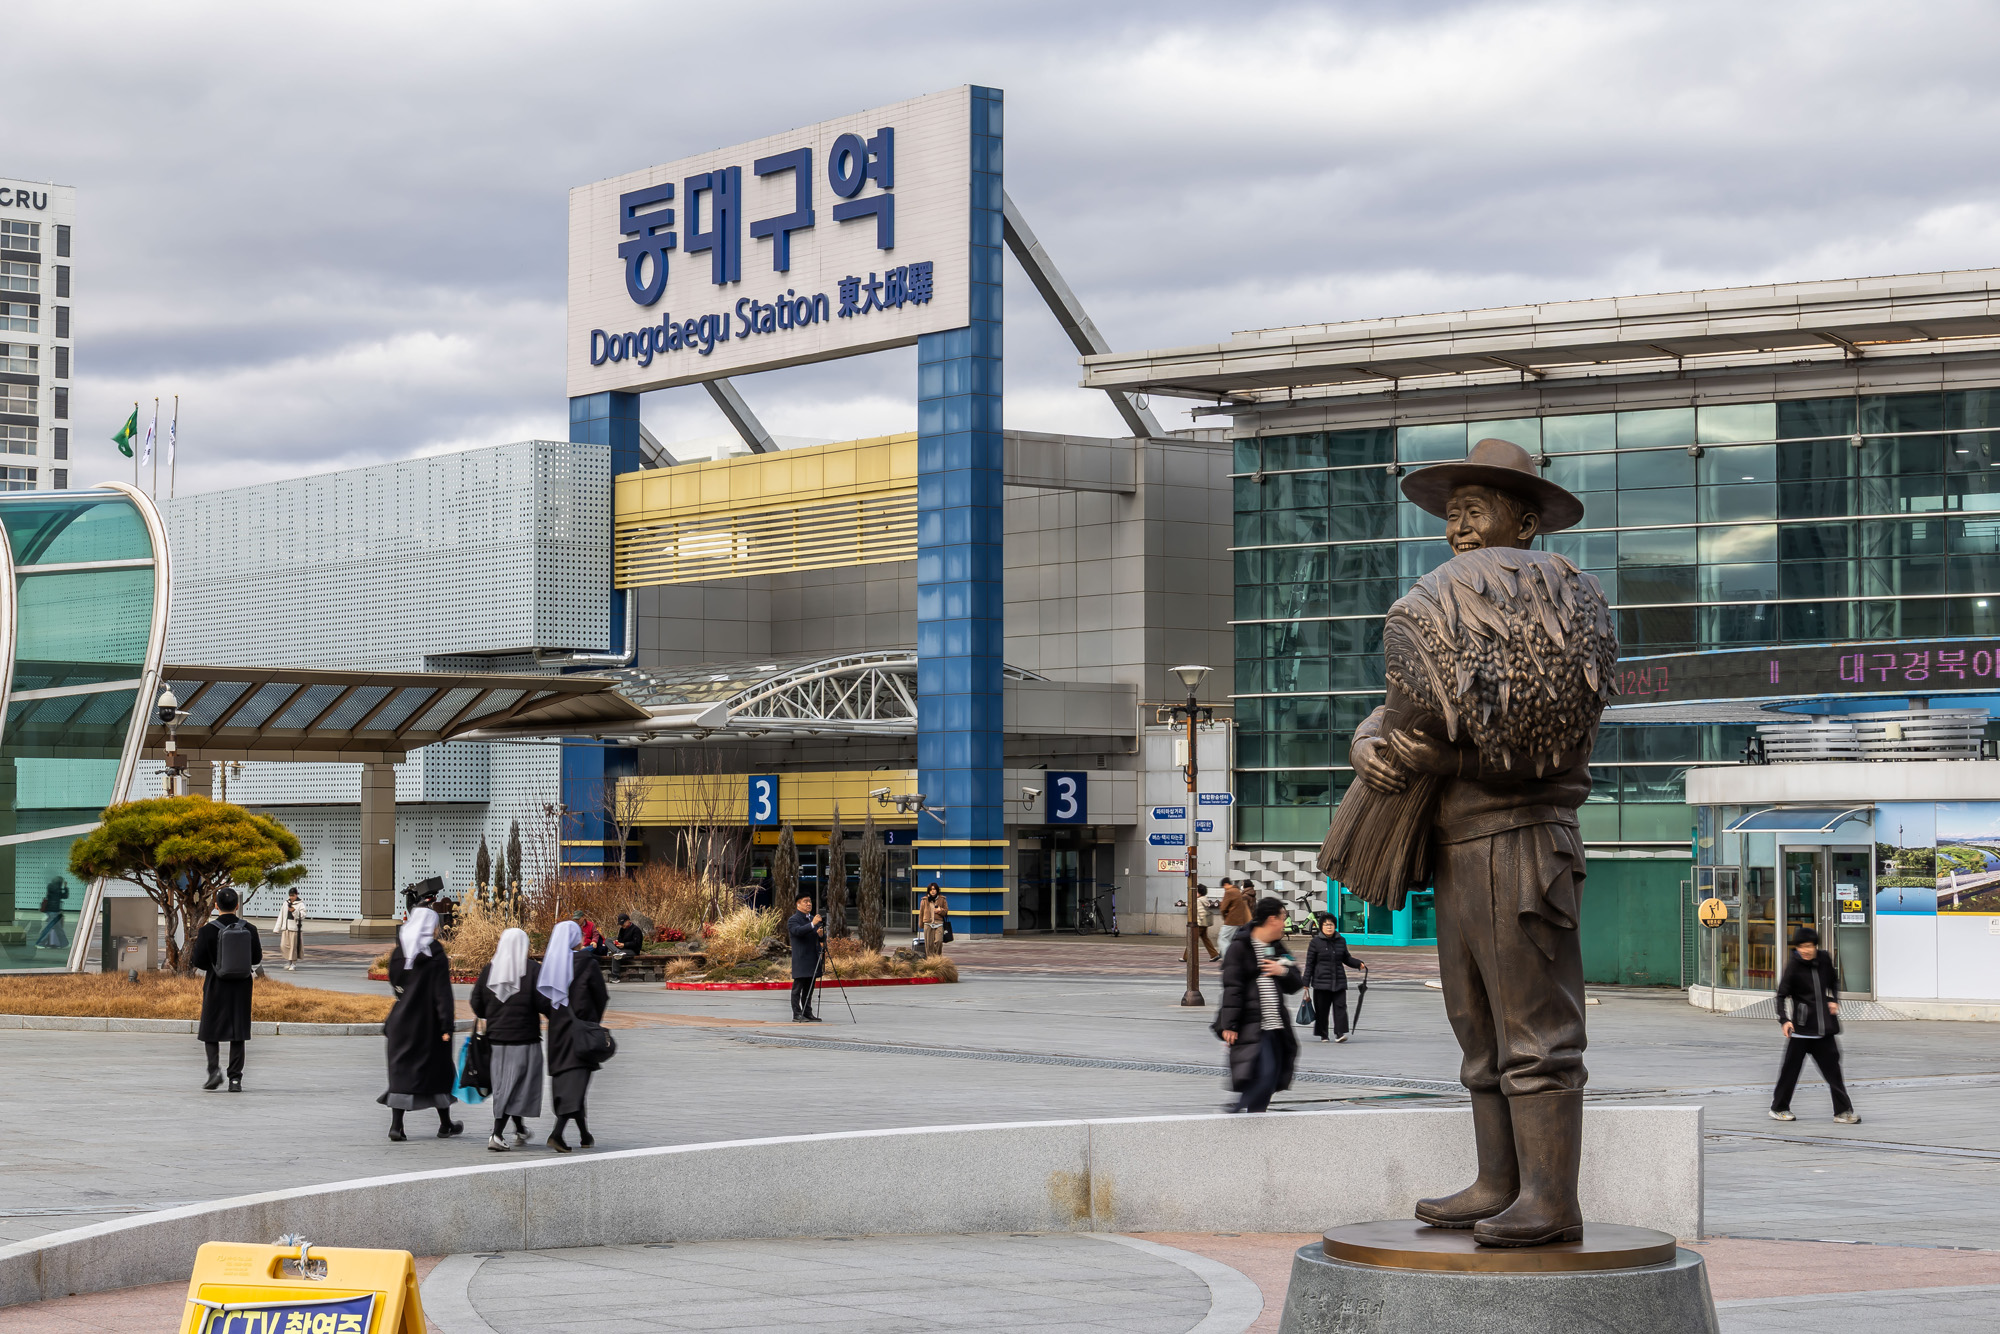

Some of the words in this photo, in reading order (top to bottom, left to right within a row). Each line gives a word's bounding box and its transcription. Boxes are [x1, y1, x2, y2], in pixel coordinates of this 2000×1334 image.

[0, 187, 47, 210] CRU
[618, 127, 894, 307] 동대구역
[590, 310, 731, 367] Dongdaegu
[735, 289, 829, 338] Station
[837, 261, 934, 317] 東大邱驛
[1613, 667, 1669, 695] 12신고
[755, 779, 772, 821] 3
[1056, 777, 1078, 819] 3
[757, 832, 762, 843] 3
[889, 831, 894, 844] 3
[205, 1309, 281, 1334] CCTV
